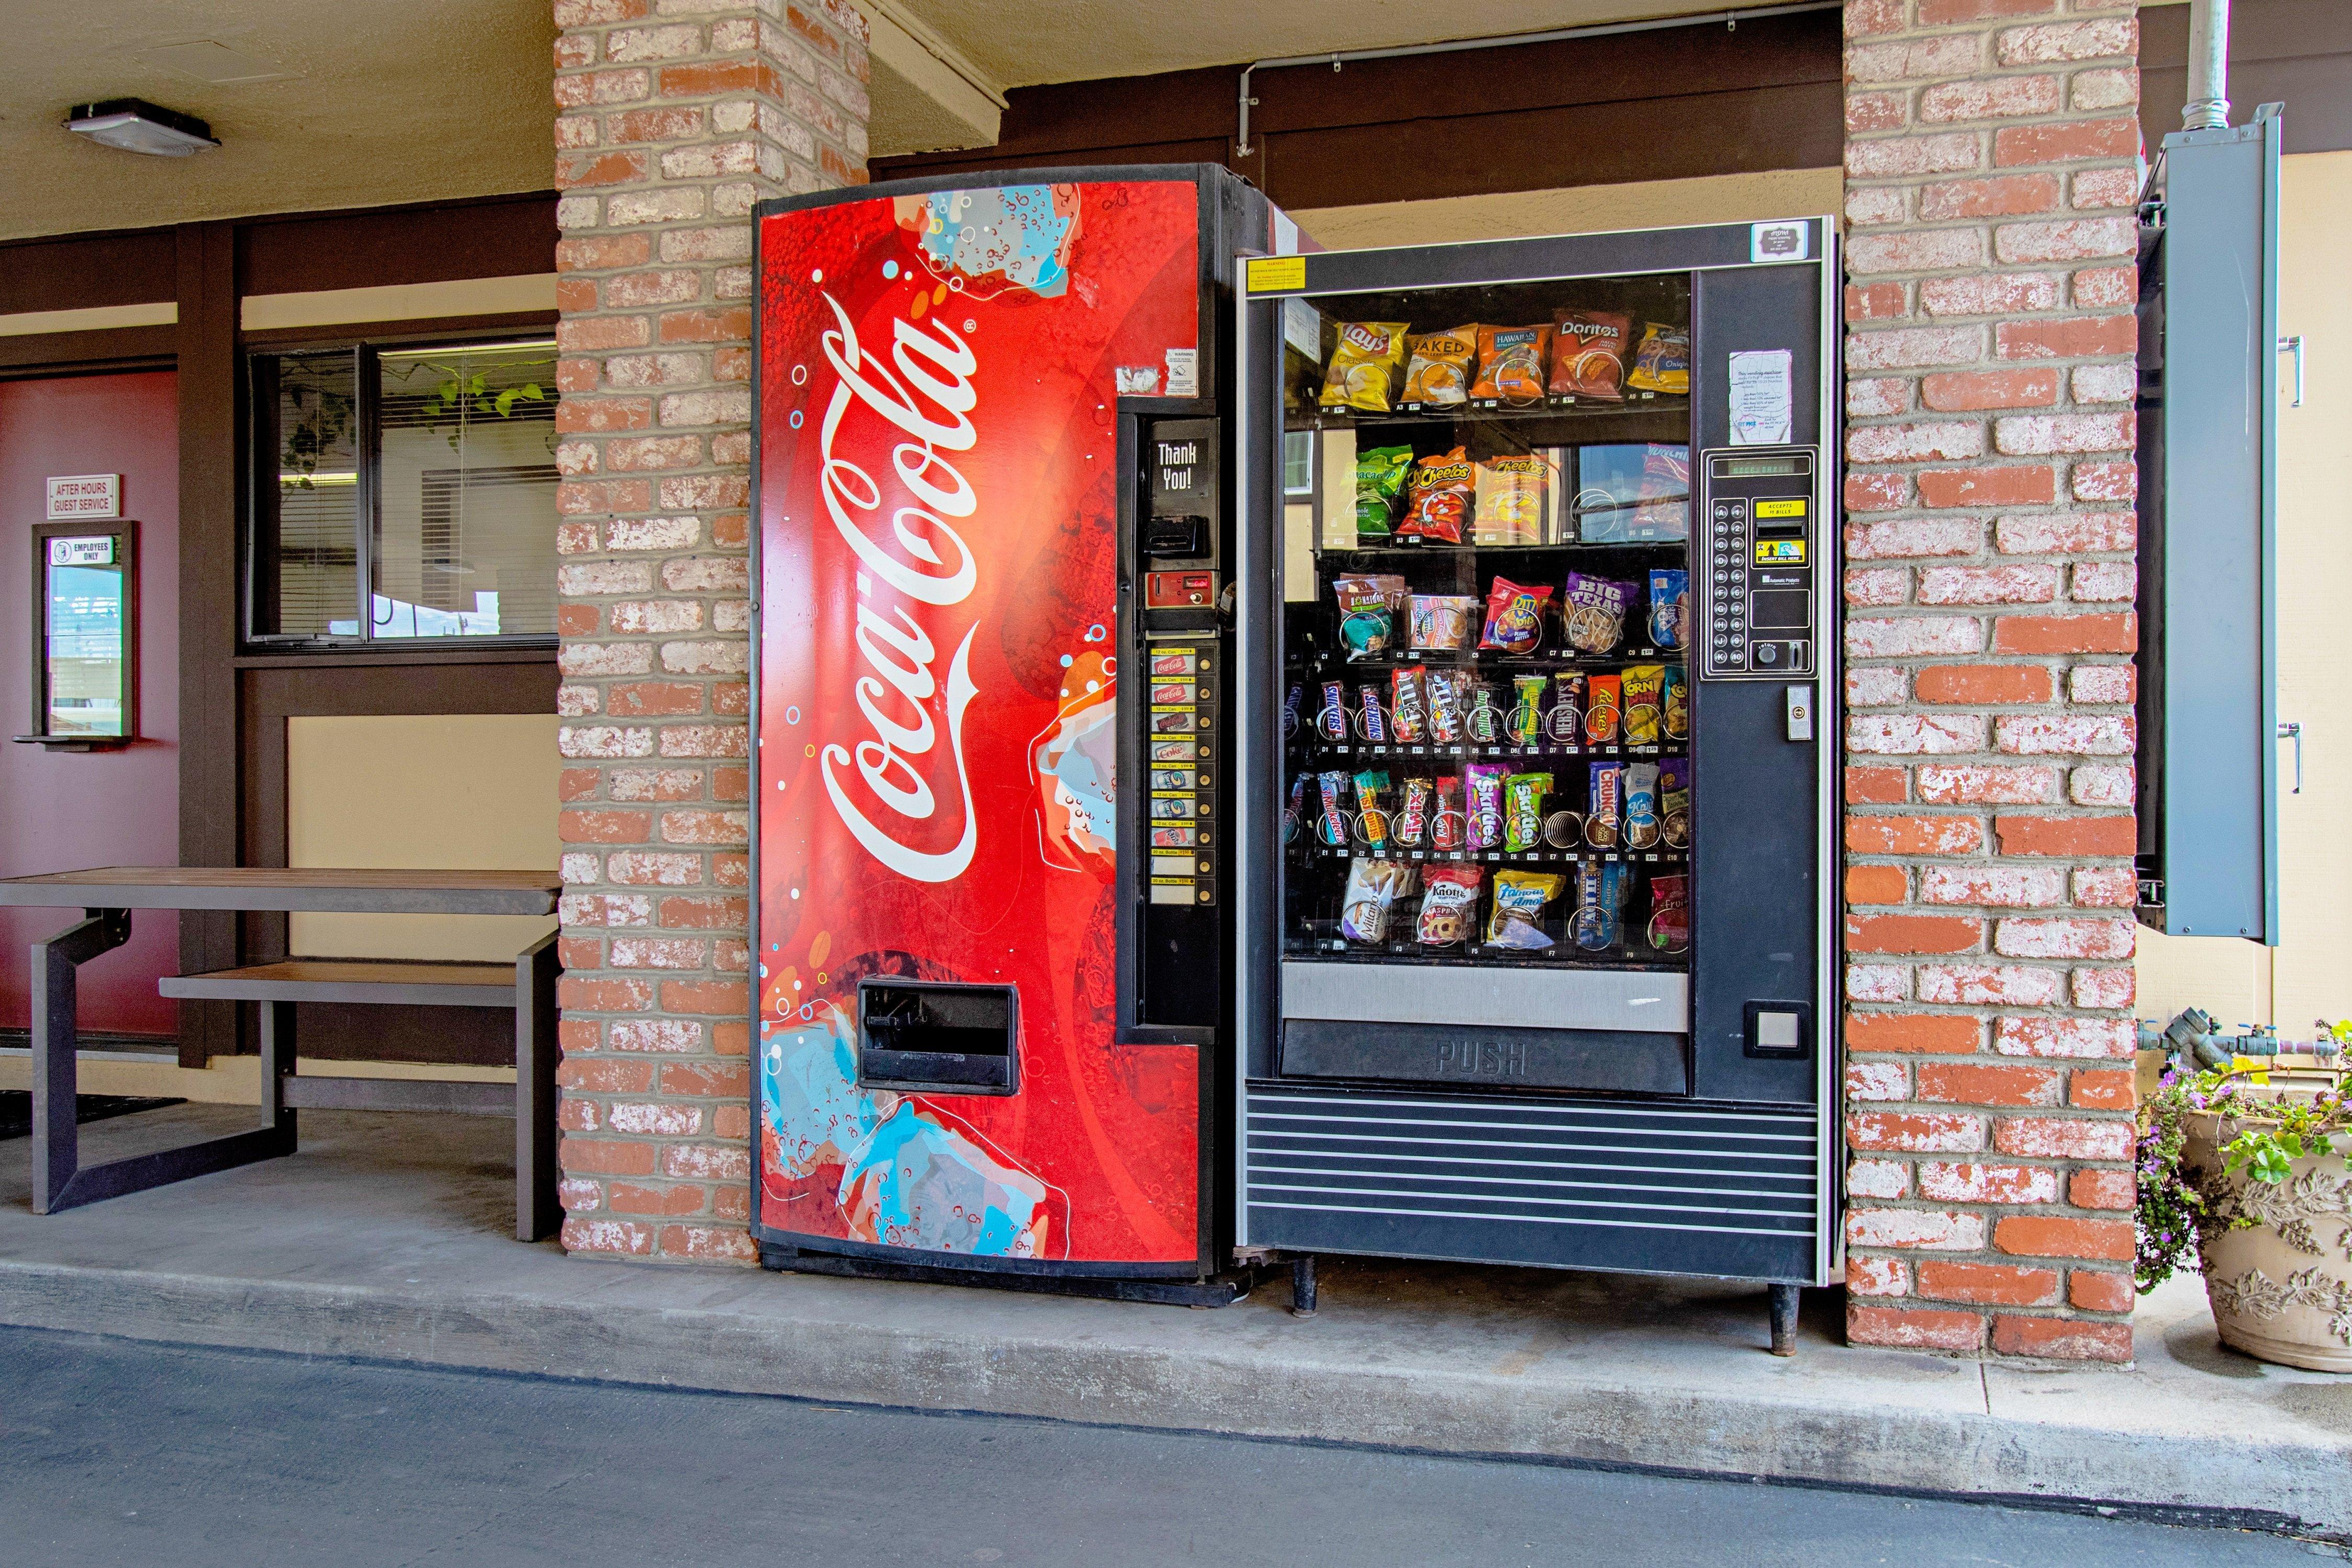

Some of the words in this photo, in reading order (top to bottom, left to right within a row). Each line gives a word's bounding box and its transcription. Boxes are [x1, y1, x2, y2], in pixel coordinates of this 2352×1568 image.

[1344, 325, 1385, 352] Lay's
[1561, 321, 1619, 338] Doritos
[1158, 442, 1197, 465] Thank
[1163, 467, 1192, 490] You!
[1420, 464, 1469, 488] Cheetos
[1495, 460, 1546, 479] Cheetos
[56, 483, 79, 495] AFTER
[81, 482, 107, 494] HOURS
[54, 500, 77, 512] GUEST
[78, 498, 109, 511] SERVICE
[74, 543, 108, 551] EMPLOYEES
[820, 291, 979, 883] Coca-Cola
[1577, 580, 1622, 601] BIG
[1512, 596, 1537, 616] RITZ
[1571, 591, 1622, 615] TEXAS
[1516, 616, 1535, 627] bits
[1623, 680, 1654, 697] CORN
[1326, 686, 1341, 731] SNICKERS
[1365, 695, 1382, 740] SNICKERS
[1598, 688, 1613, 733] Reese's
[1477, 709, 1492, 736] Milky
[1160, 746, 1183, 759] Coke
[1321, 786, 1331, 795] 3
[1601, 771, 1615, 824] CRUNCH
[1404, 792, 1423, 841] TWIX
[1475, 779, 1496, 846] Skittles
[1516, 785, 1537, 845] Skittles
[1436, 817, 1448, 838] KitKat
[1496, 883, 1544, 900] Famous
[1511, 896, 1544, 906] Amos
[1361, 895, 1379, 939] Milano
[1436, 1041, 1525, 1076] PUSH
